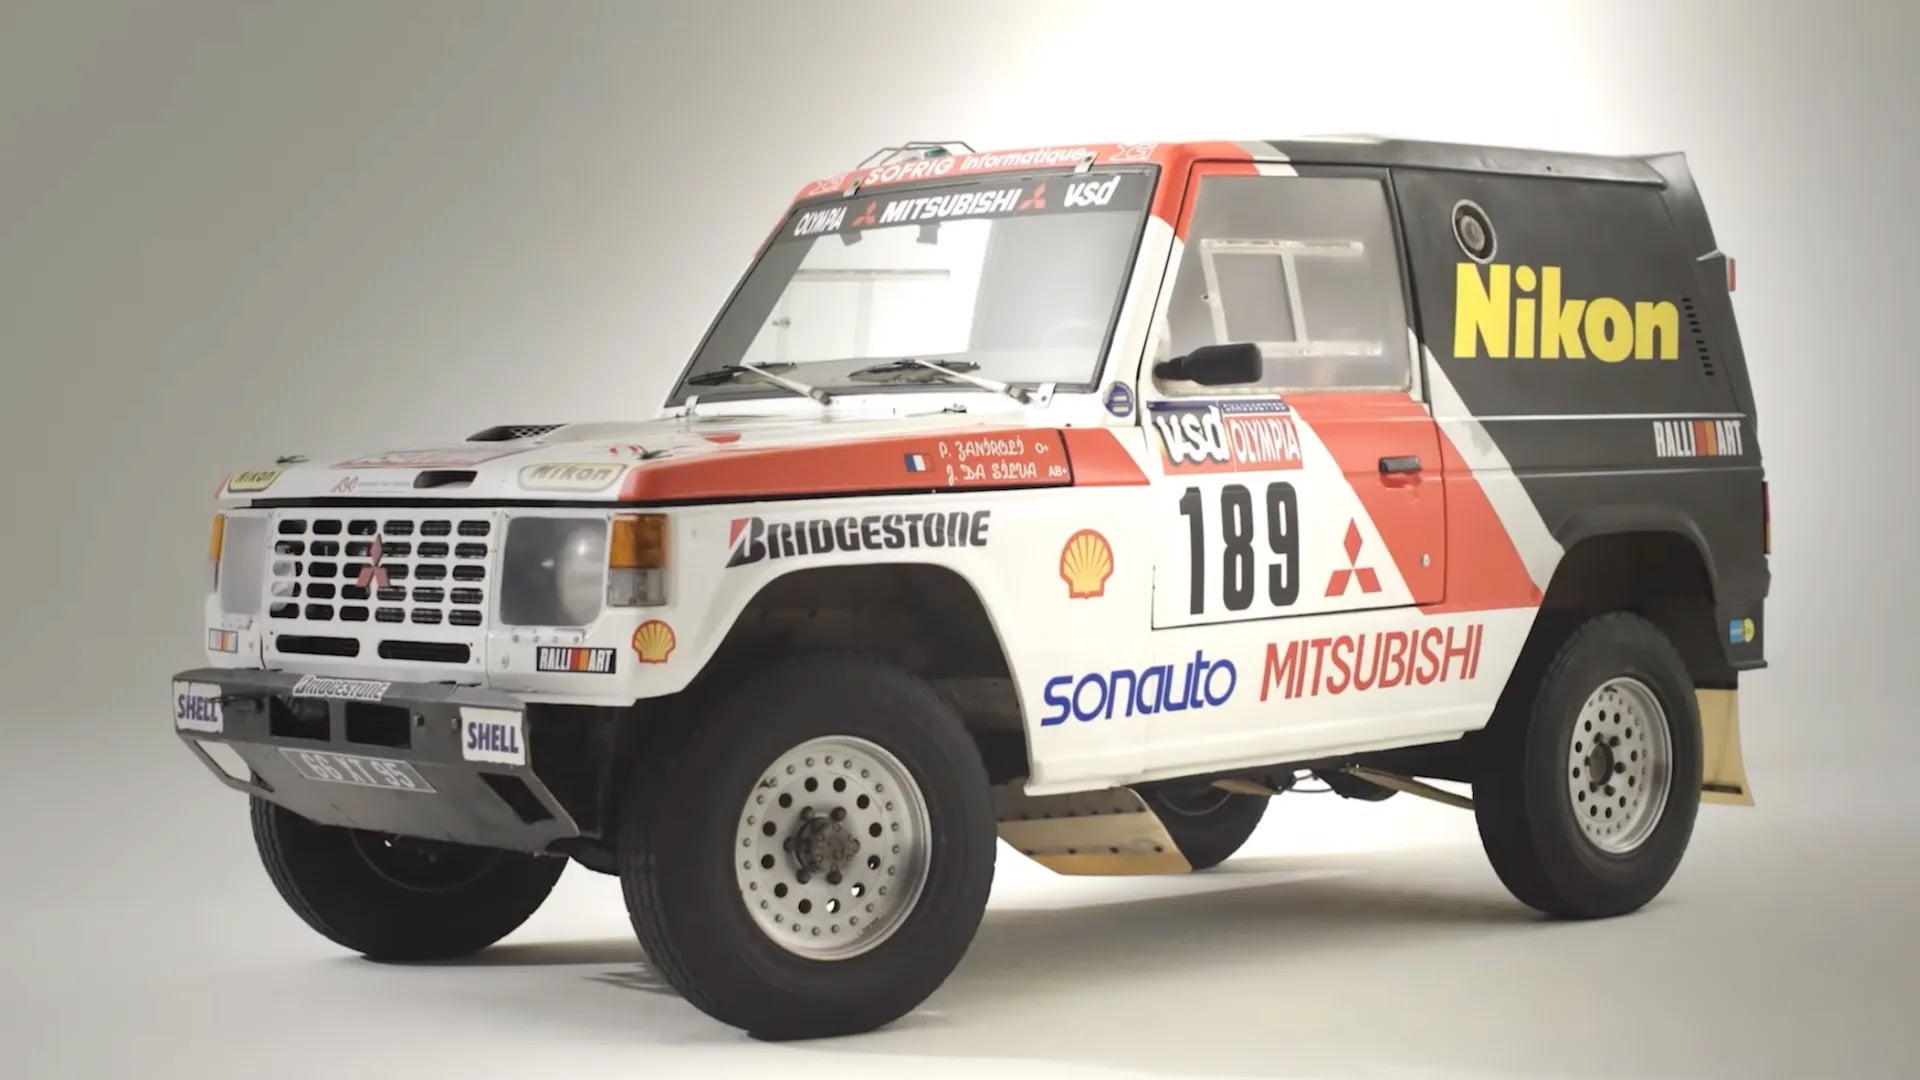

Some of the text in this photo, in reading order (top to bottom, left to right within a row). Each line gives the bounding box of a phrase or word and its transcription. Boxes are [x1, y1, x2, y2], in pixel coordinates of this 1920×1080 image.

[865, 157, 954, 185] SOFRIG
[794, 176, 1121, 236] OLYMPIA MITSUBISHI vsd
[1454, 263, 1680, 363] Nikon
[939, 441, 952, 458] P.
[1157, 405, 1231, 465] vsd
[1231, 418, 1302, 464] OLYMPIA
[234, 470, 277, 483] Nikon
[531, 464, 613, 481] Nikon
[946, 458, 1067, 486] J. DA SILVA AB+
[725, 510, 991, 568] BRIDGESTONE
[1179, 481, 1300, 615] 189
[295, 676, 390, 699] BRIDGESTONE
[1041, 624, 1483, 727] sonauto MITSUBISHI
[178, 694, 218, 722] SHELL
[467, 721, 519, 754] SHELL
[300, 753, 344, 781] 66
[371, 760, 415, 788] 95
